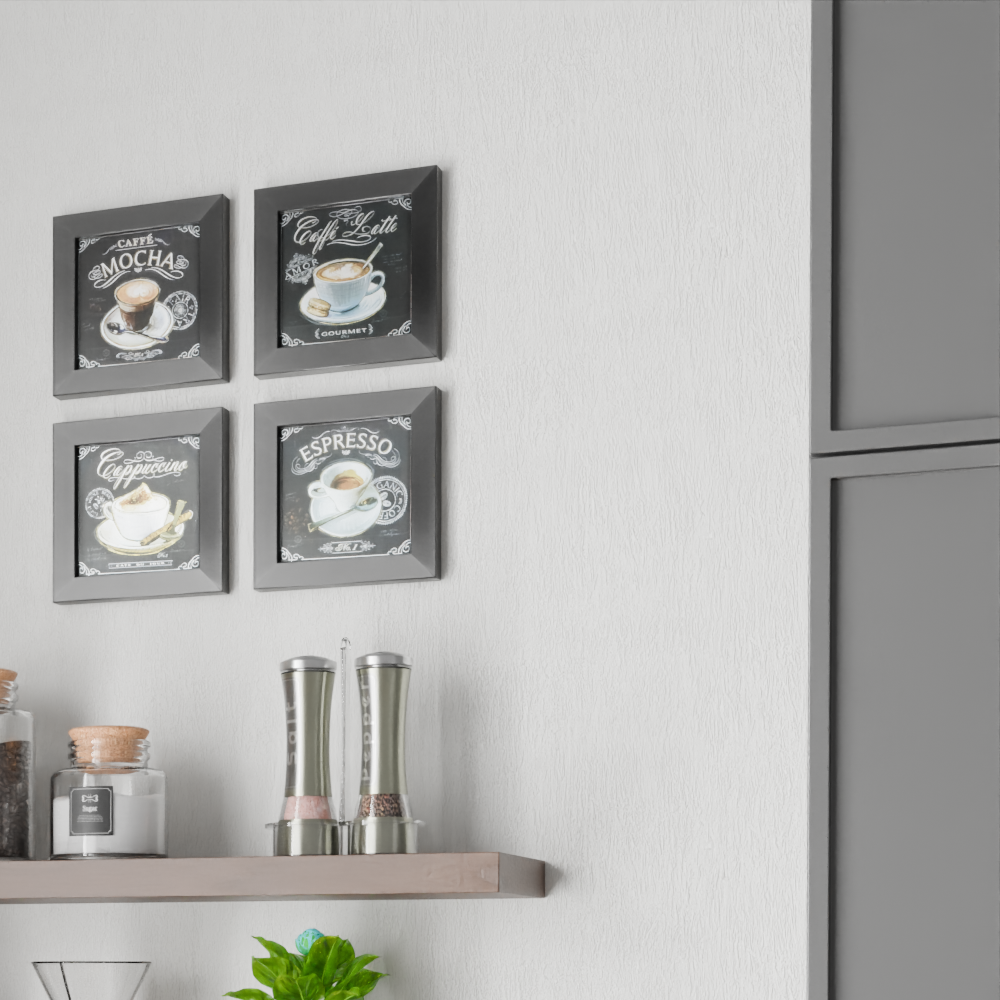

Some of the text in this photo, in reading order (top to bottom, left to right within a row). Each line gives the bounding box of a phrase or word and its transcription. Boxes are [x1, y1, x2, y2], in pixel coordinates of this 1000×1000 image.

[341, 210, 399, 238] Latte
[117, 233, 154, 248] CAFFÉ
[100, 249, 174, 278] MOCHA
[285, 258, 319, 281] AMOR
[320, 327, 368, 337] GOURMET
[299, 432, 393, 463] ESPRESSO
[96, 447, 189, 491] Cappuccino
